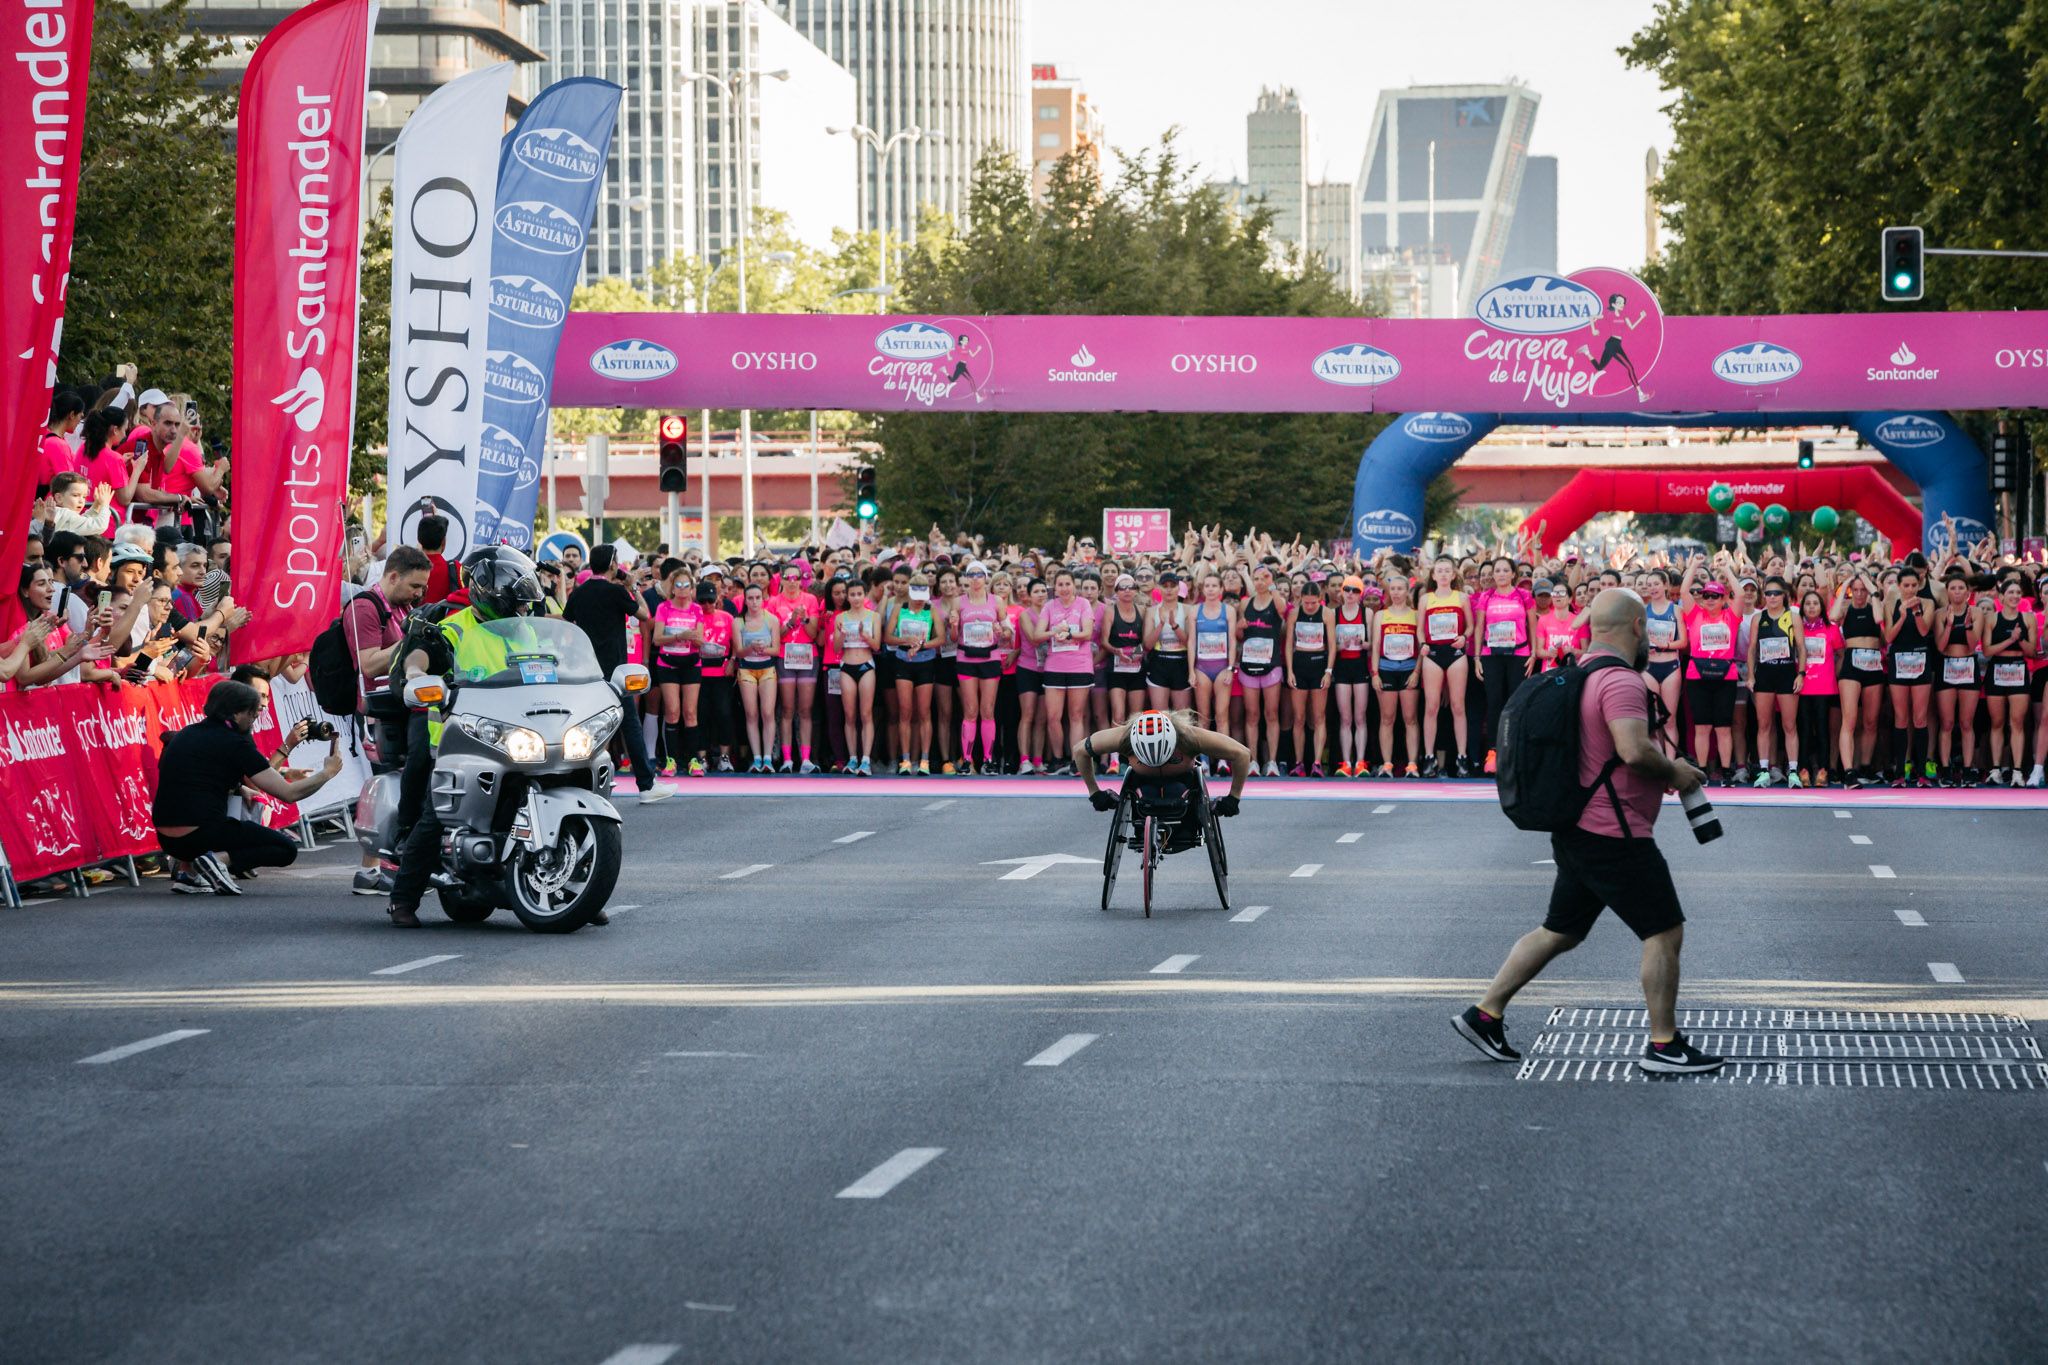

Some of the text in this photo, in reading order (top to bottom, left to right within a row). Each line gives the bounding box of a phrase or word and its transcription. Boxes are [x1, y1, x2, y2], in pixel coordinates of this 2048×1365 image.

[518, 138, 597, 176] ASTURIANA
[500, 210, 576, 249] ASTURIANA
[1485, 297, 1590, 318] ASTURIANA
[274, 85, 331, 610] Sports Santander
[882, 335, 948, 350] ASTURIANA
[1464, 330, 1568, 360] Carrera
[598, 354, 670, 370] ASTURIANA
[731, 351, 817, 371] OYSHO
[868, 356, 933, 376] Carrera
[1170, 354, 1257, 374] OYSHO
[1319, 359, 1393, 376] ASTURIANA
[1720, 357, 1794, 374] ASTURIANA
[1995, 349, 2048, 368] OYS
[400, 177, 478, 561] OYSHO
[1048, 369, 1117, 383] Santander
[1867, 367, 1939, 381] Santander
[884, 373, 956, 406] de la Mujer
[1488, 357, 1607, 408] de la Mujer
[1114, 515, 1143, 528] SUB
